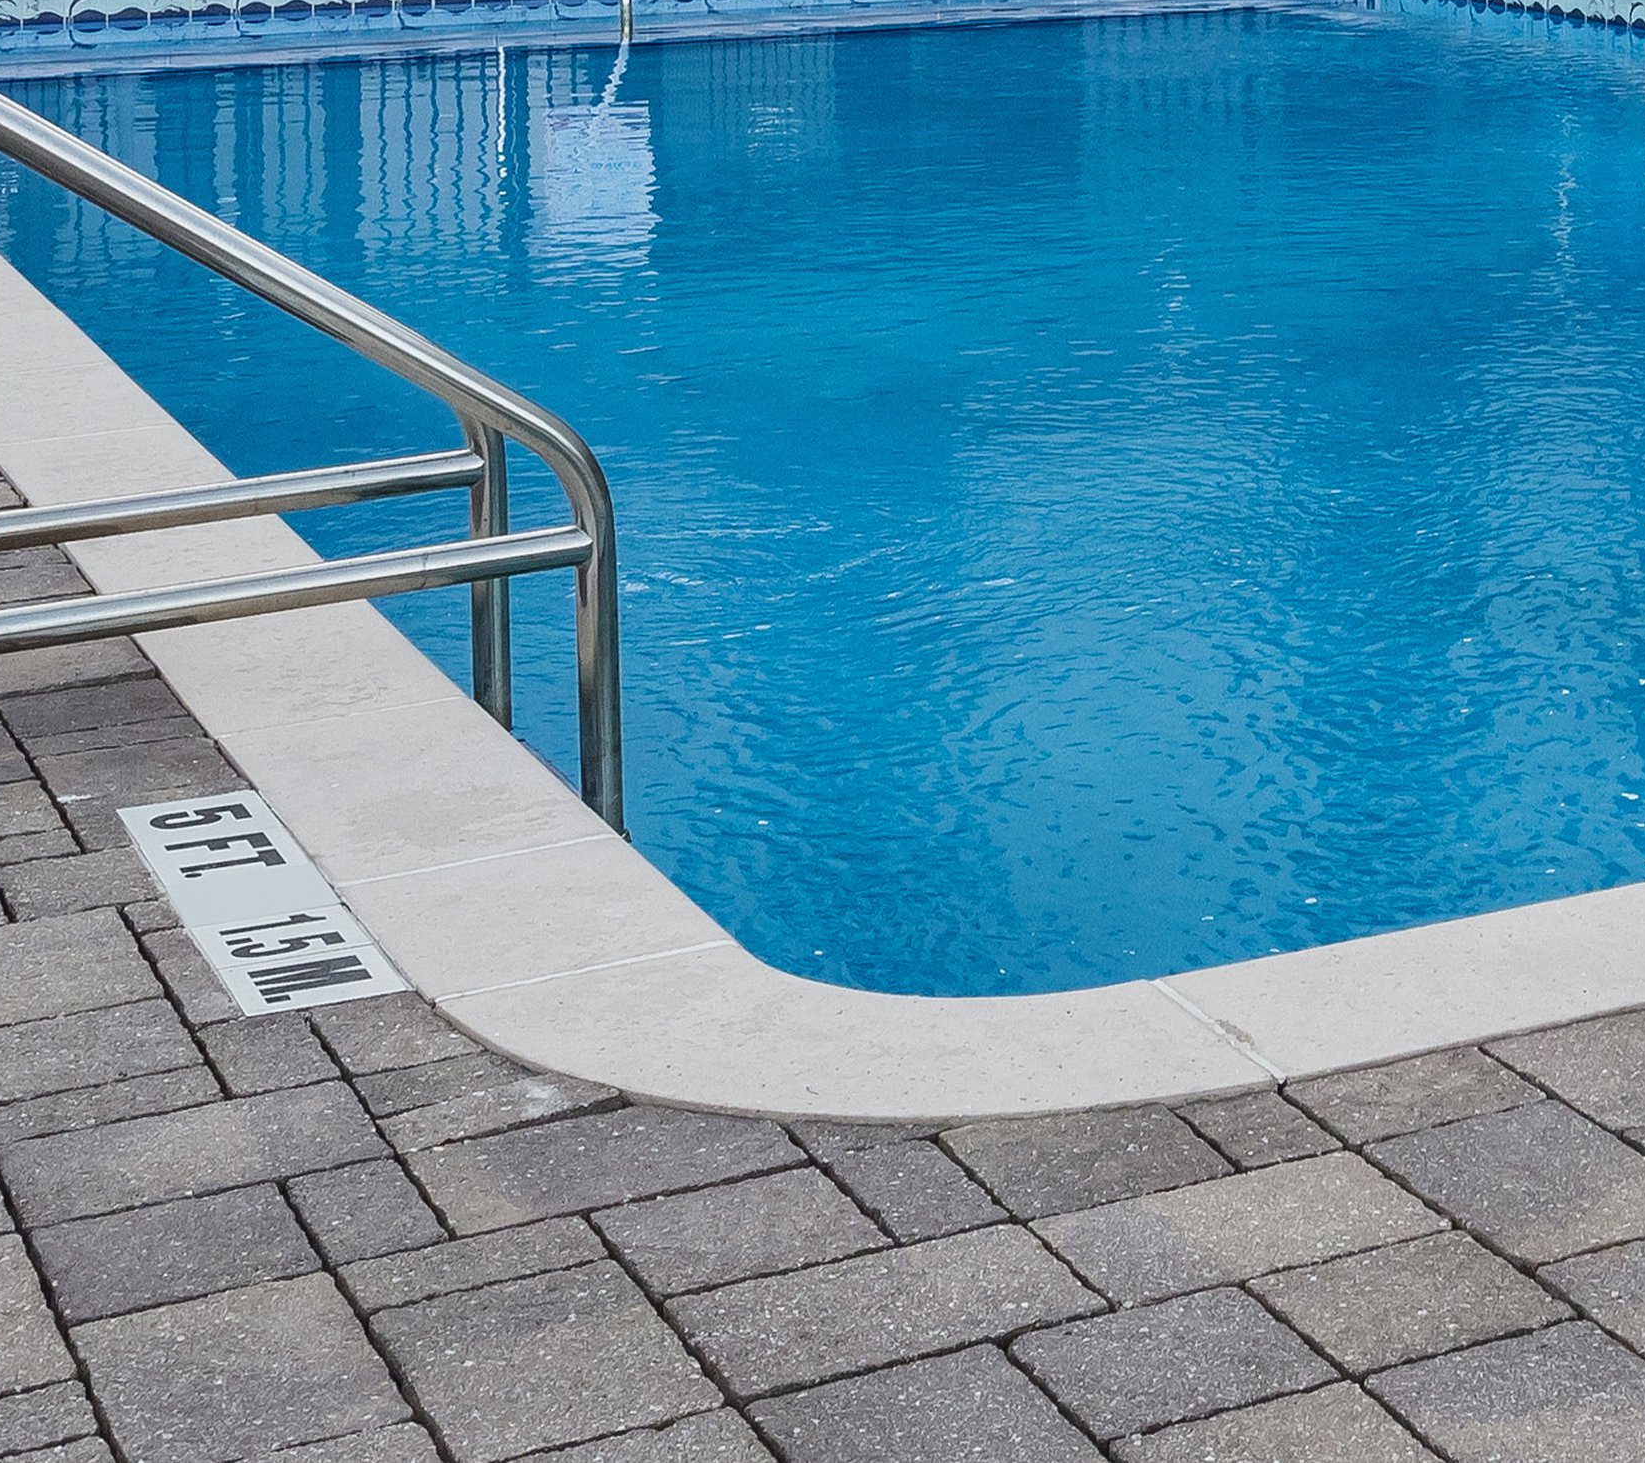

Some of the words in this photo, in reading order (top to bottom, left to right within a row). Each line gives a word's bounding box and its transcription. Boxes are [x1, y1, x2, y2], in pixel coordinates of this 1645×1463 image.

[149, 803, 253, 831] 5
[164, 832, 287, 879] FT.
[219, 913, 346, 959] 1.5
[247, 954, 373, 1004] M.
